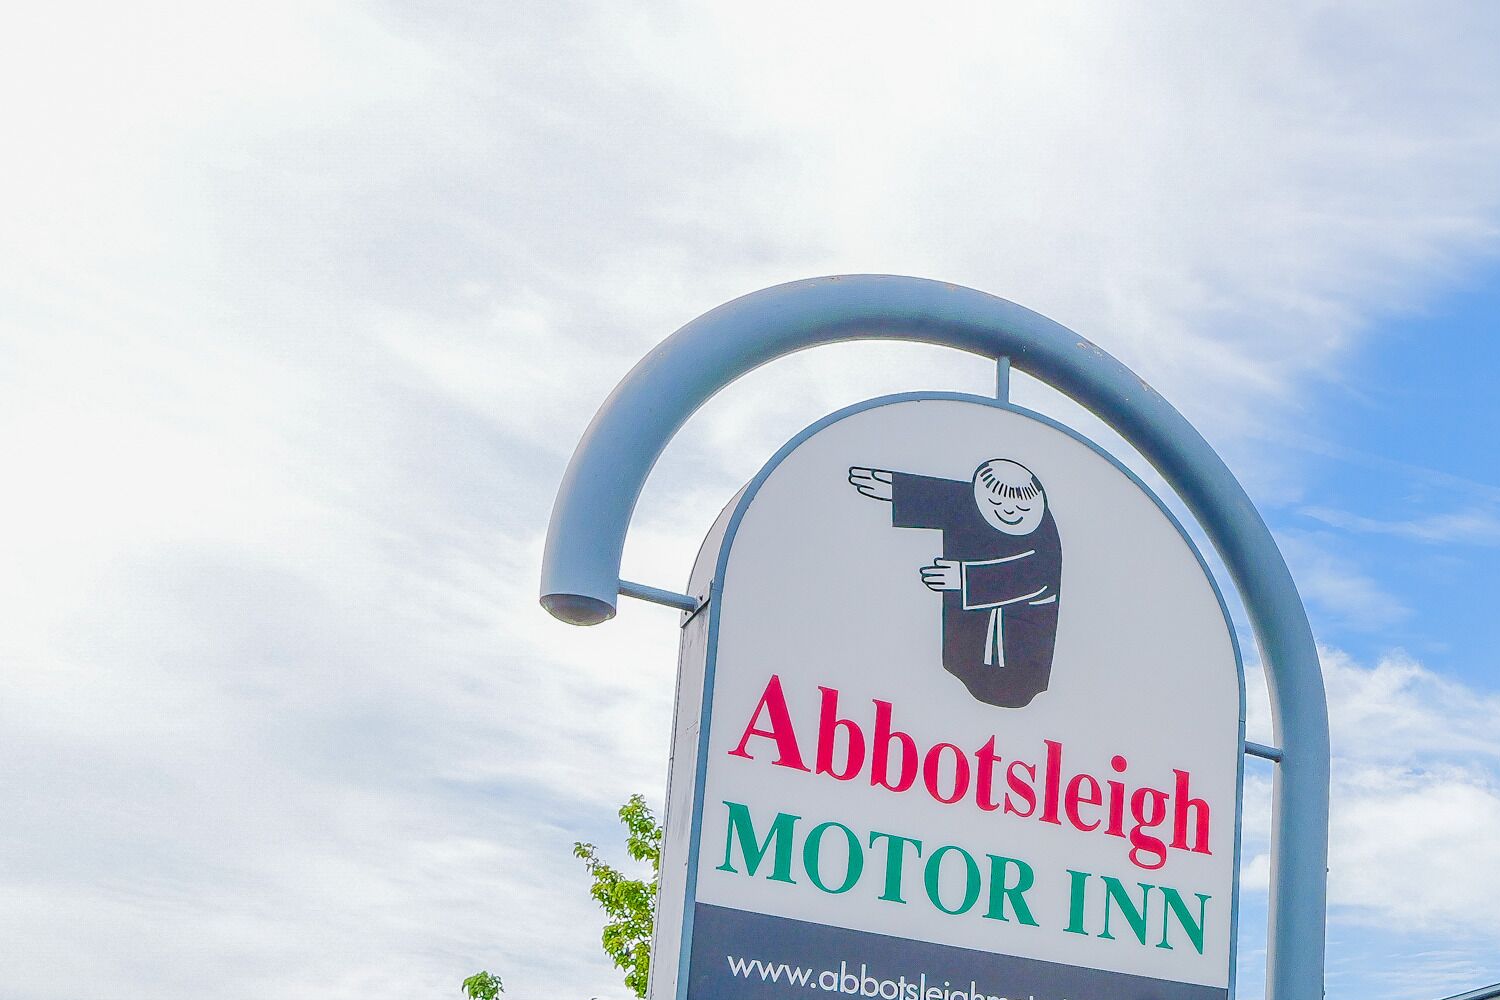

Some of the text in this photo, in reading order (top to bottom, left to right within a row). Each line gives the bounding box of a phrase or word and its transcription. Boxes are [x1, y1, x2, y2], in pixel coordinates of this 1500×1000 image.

[728, 674, 1212, 869] Abbotsleigh
[716, 801, 1212, 955] MOTOR INN
